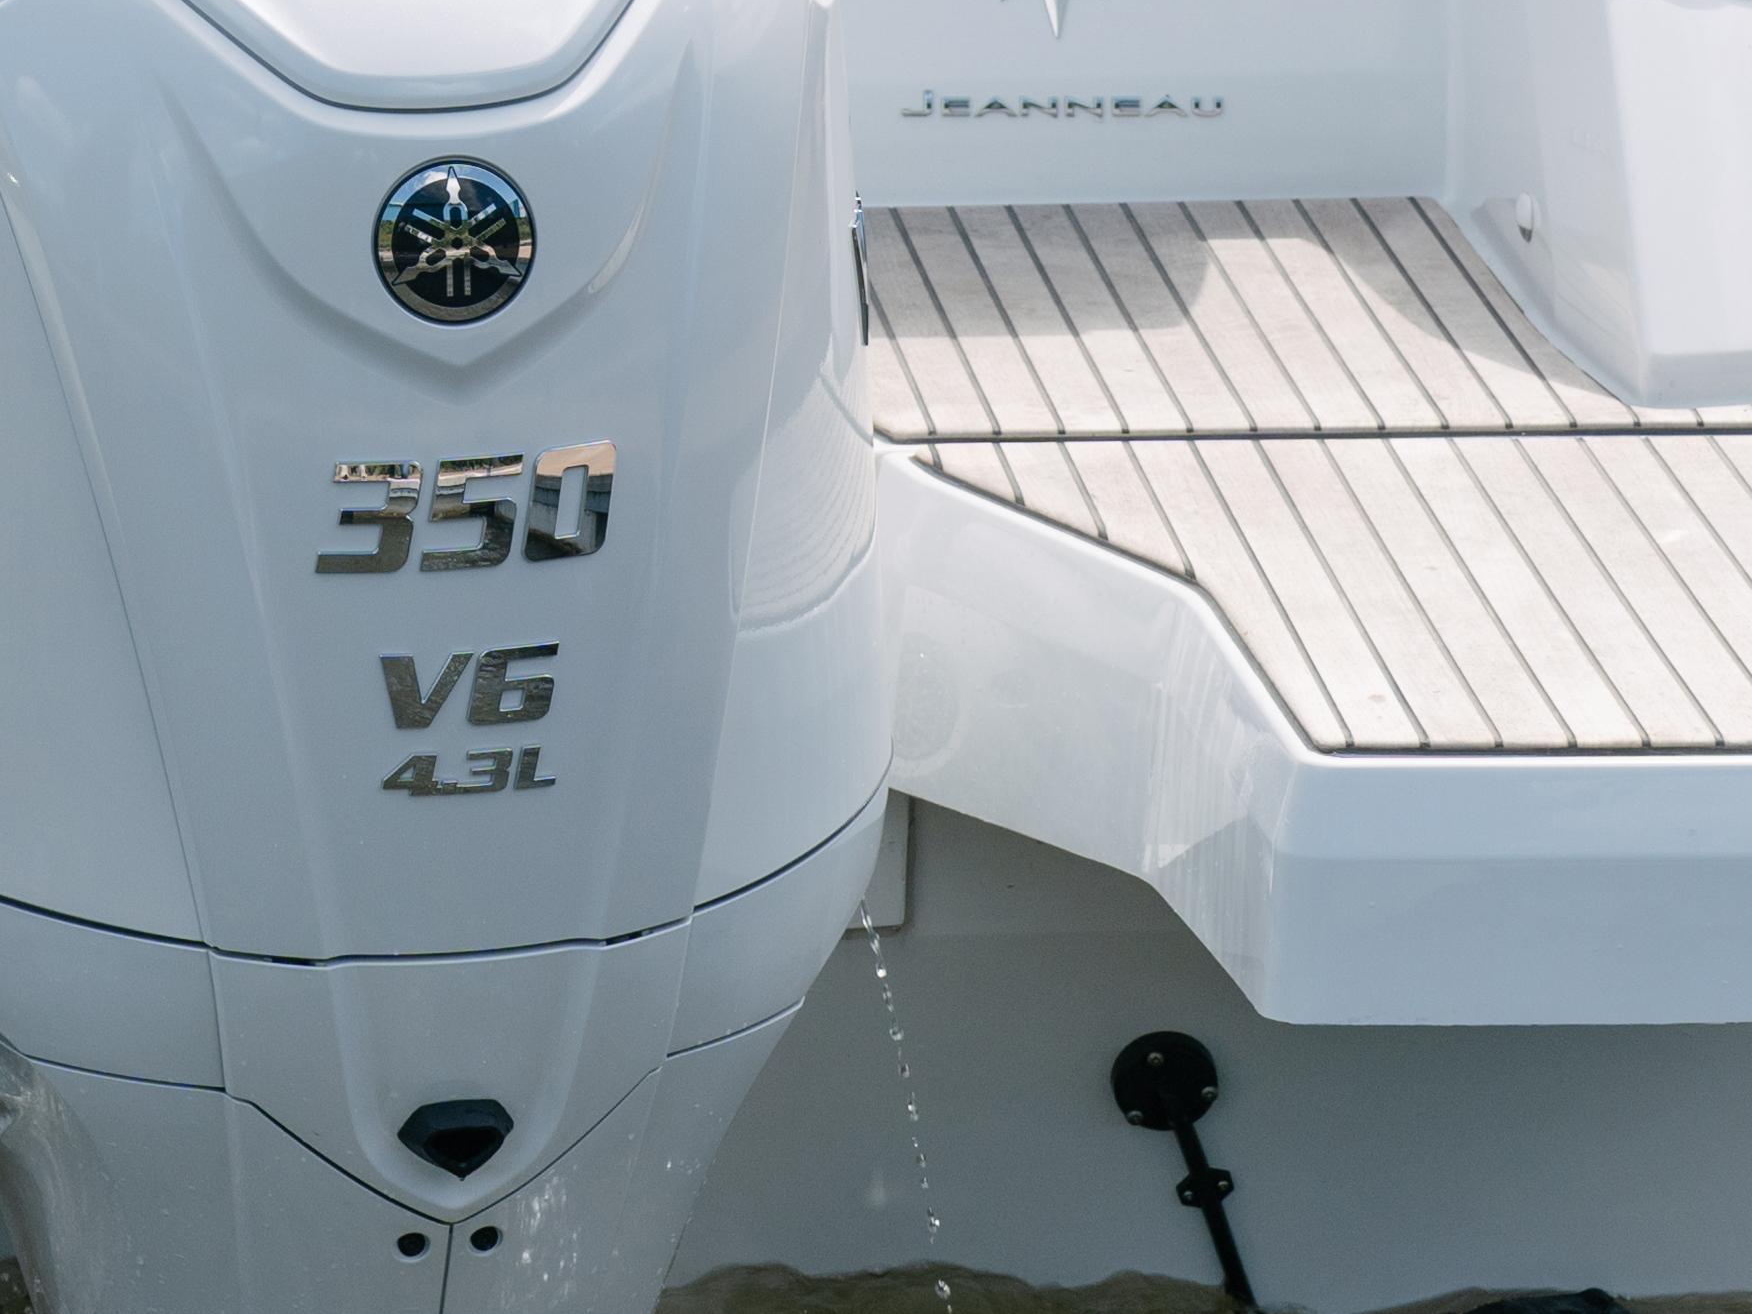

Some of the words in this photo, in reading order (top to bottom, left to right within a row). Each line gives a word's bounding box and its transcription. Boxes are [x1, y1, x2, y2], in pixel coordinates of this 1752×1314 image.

[314, 439, 618, 574] 350
[378, 640, 560, 729] V6
[381, 743, 557, 797] 4.3L
